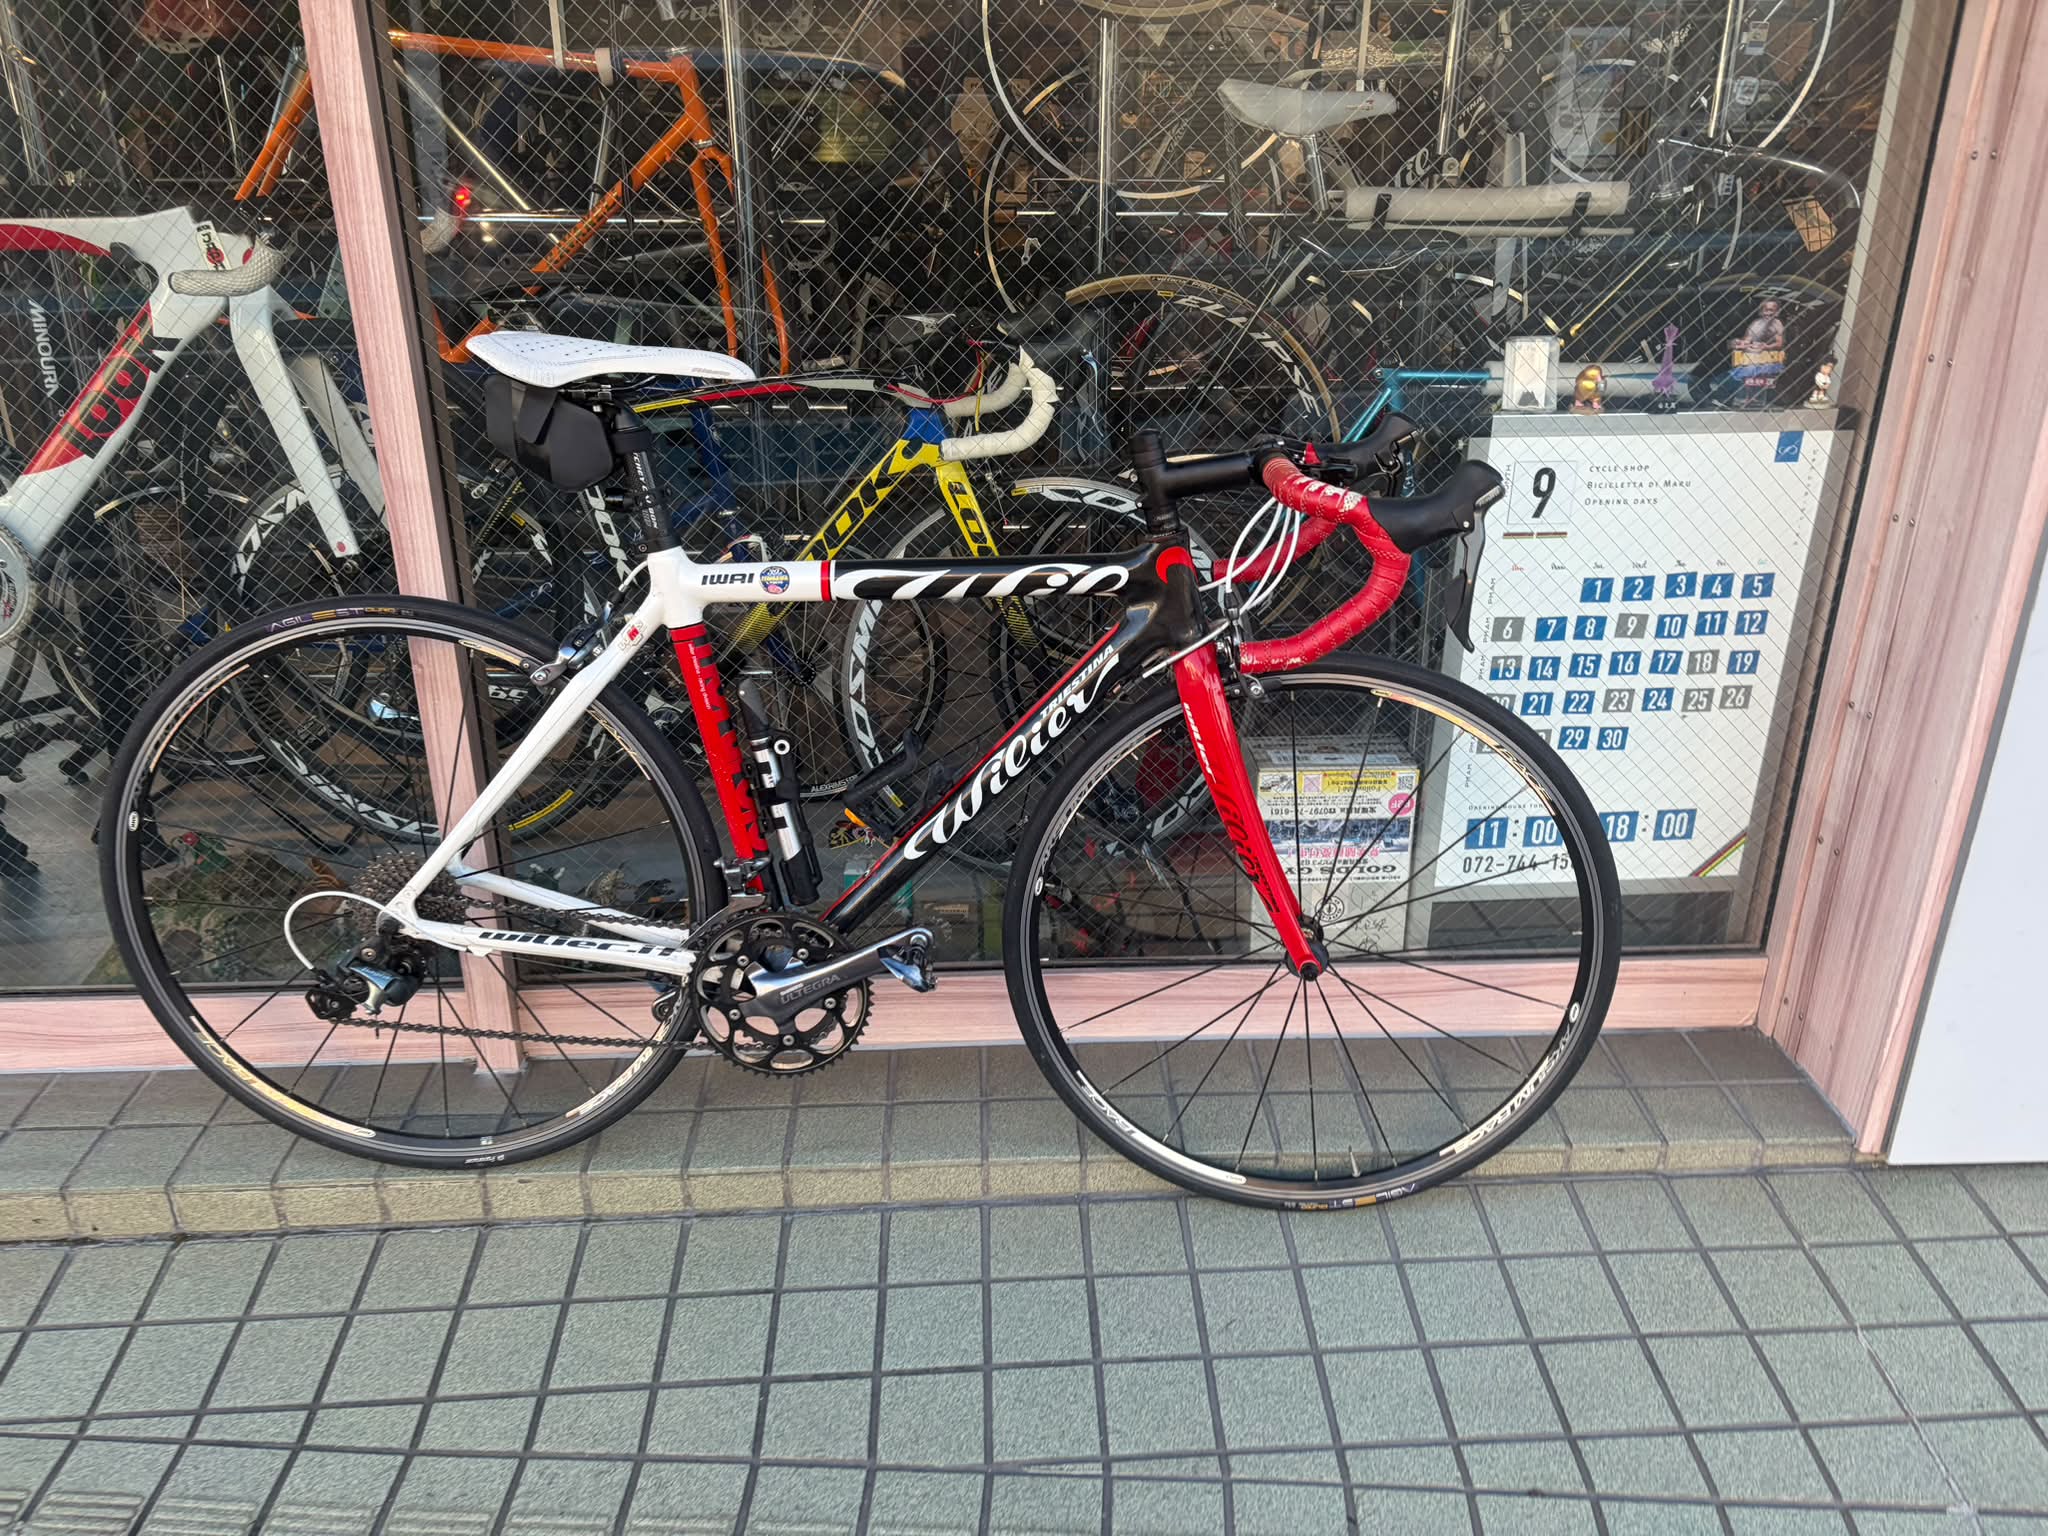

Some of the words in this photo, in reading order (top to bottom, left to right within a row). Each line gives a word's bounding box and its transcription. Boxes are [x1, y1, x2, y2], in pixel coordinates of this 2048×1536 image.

[28, 300, 60, 397] MINOURA
[59, 316, 183, 459] LOOK
[1589, 464, 1618, 473] CYCLE
[1623, 463, 1650, 472] SHOP
[1531, 467, 1556, 519] 9
[701, 573, 755, 586] IWAI
[1595, 580, 1602, 600] 1
[1633, 579, 1643, 599] 2
[1676, 576, 1686, 595] 3
[1712, 576, 1722, 596] 4
[1753, 576, 1763, 595] 5
[1503, 620, 1512, 639] 6
[1548, 620, 1556, 638] 7
[1586, 618, 1595, 637] 8
[1627, 616, 1637, 636] 9
[1664, 617, 1681, 636] 10
[1705, 614, 1720, 633] 11
[1744, 613, 1761, 632] 12
[1498, 658, 1516, 677] 13
[1536, 660, 1553, 678] 14
[1577, 656, 1595, 675] 15
[1618, 654, 1634, 673] 16
[1658, 653, 1676, 671] 17
[1695, 652, 1712, 672] 18
[1736, 653, 1753, 672] 19
[1040, 645, 1115, 720] TRIESTINA
[1528, 695, 1546, 713] 21
[1569, 694, 1588, 712] 22
[1608, 691, 1629, 710] 23
[1648, 690, 1667, 709] 24
[1687, 690, 1708, 710] 25
[1725, 688, 1745, 707] 26
[1564, 730, 1584, 748] 29
[1603, 730, 1622, 748] 30
[904, 652, 1120, 860] Wilier
[1463, 852, 1574, 873] 072-744-15
[781, 973, 842, 1005] ULTEGRA
